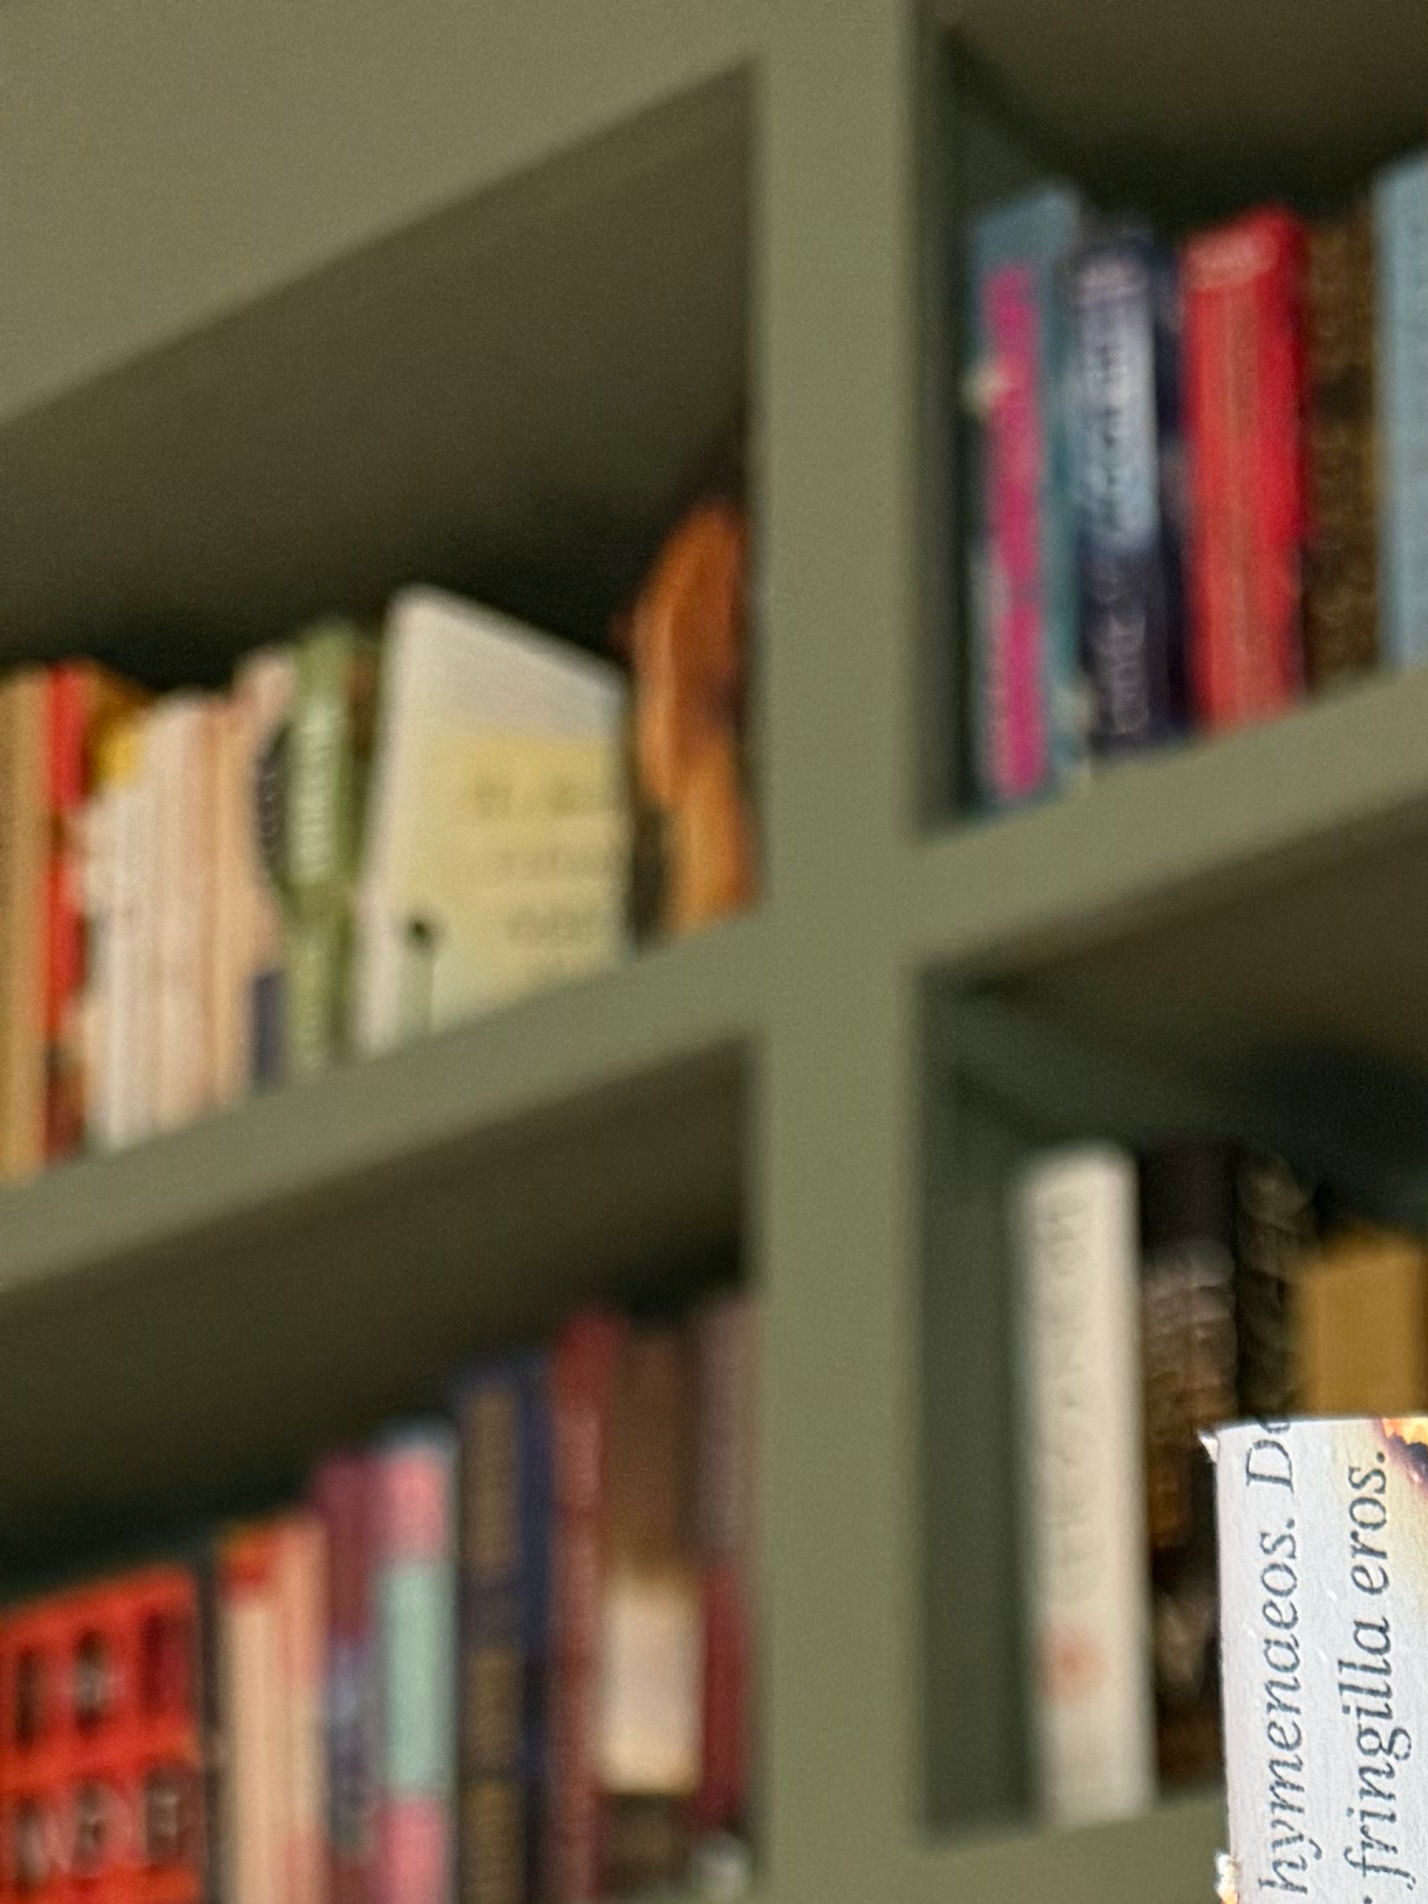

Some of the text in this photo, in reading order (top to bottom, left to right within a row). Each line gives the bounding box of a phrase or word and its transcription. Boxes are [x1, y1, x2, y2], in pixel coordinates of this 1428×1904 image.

[1349, 1450, 1390, 1598] eros.
[1258, 1516, 1322, 1894] hymenaeos.
[1338, 1617, 1417, 1890] fringilla
